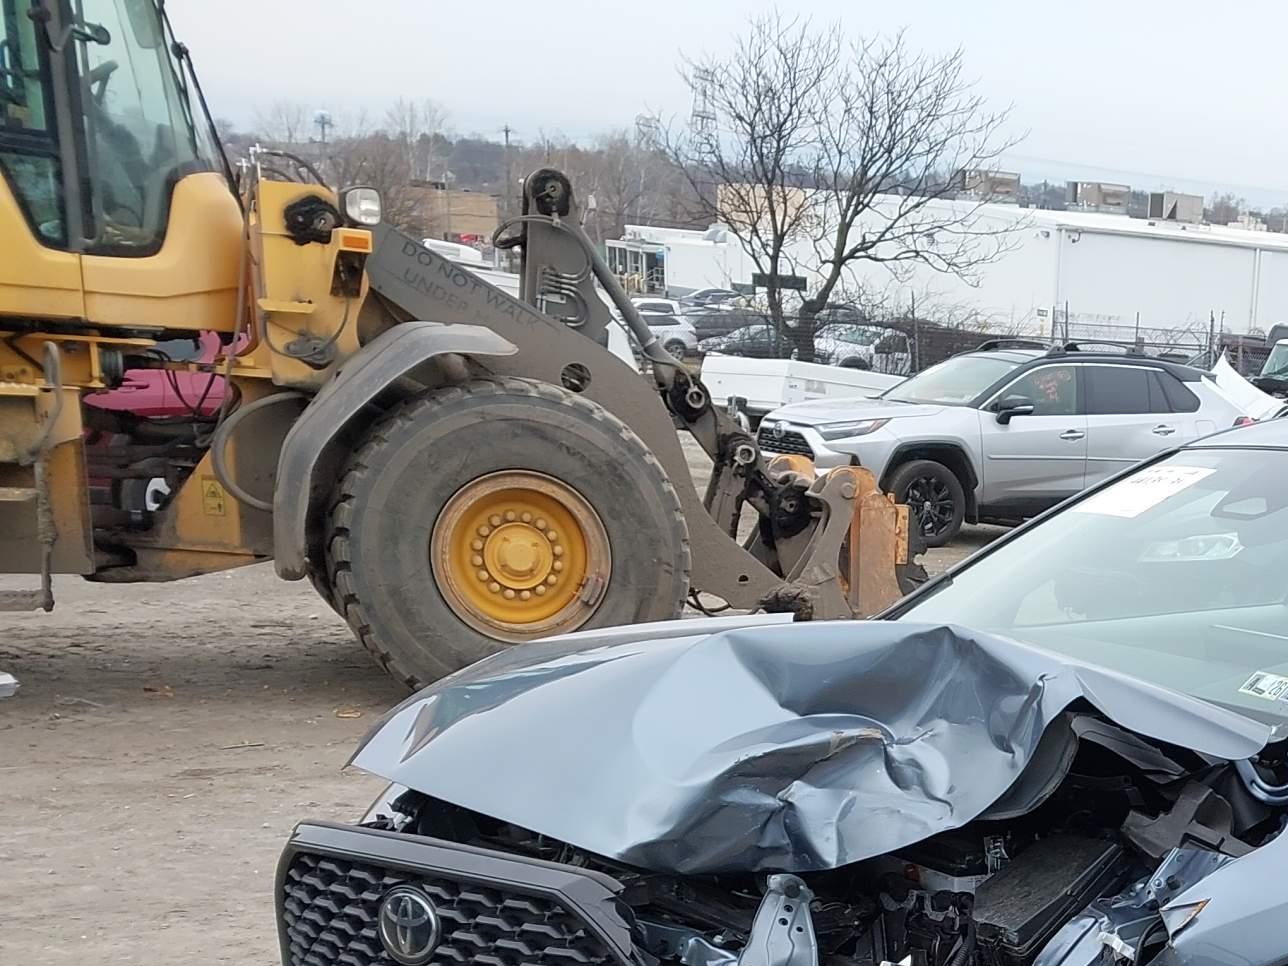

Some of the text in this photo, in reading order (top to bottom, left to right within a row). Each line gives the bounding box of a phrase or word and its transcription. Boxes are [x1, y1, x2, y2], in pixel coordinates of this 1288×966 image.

[400, 241, 432, 266] DO
[438, 263, 481, 295] NOT
[404, 267, 469, 311] UNDER
